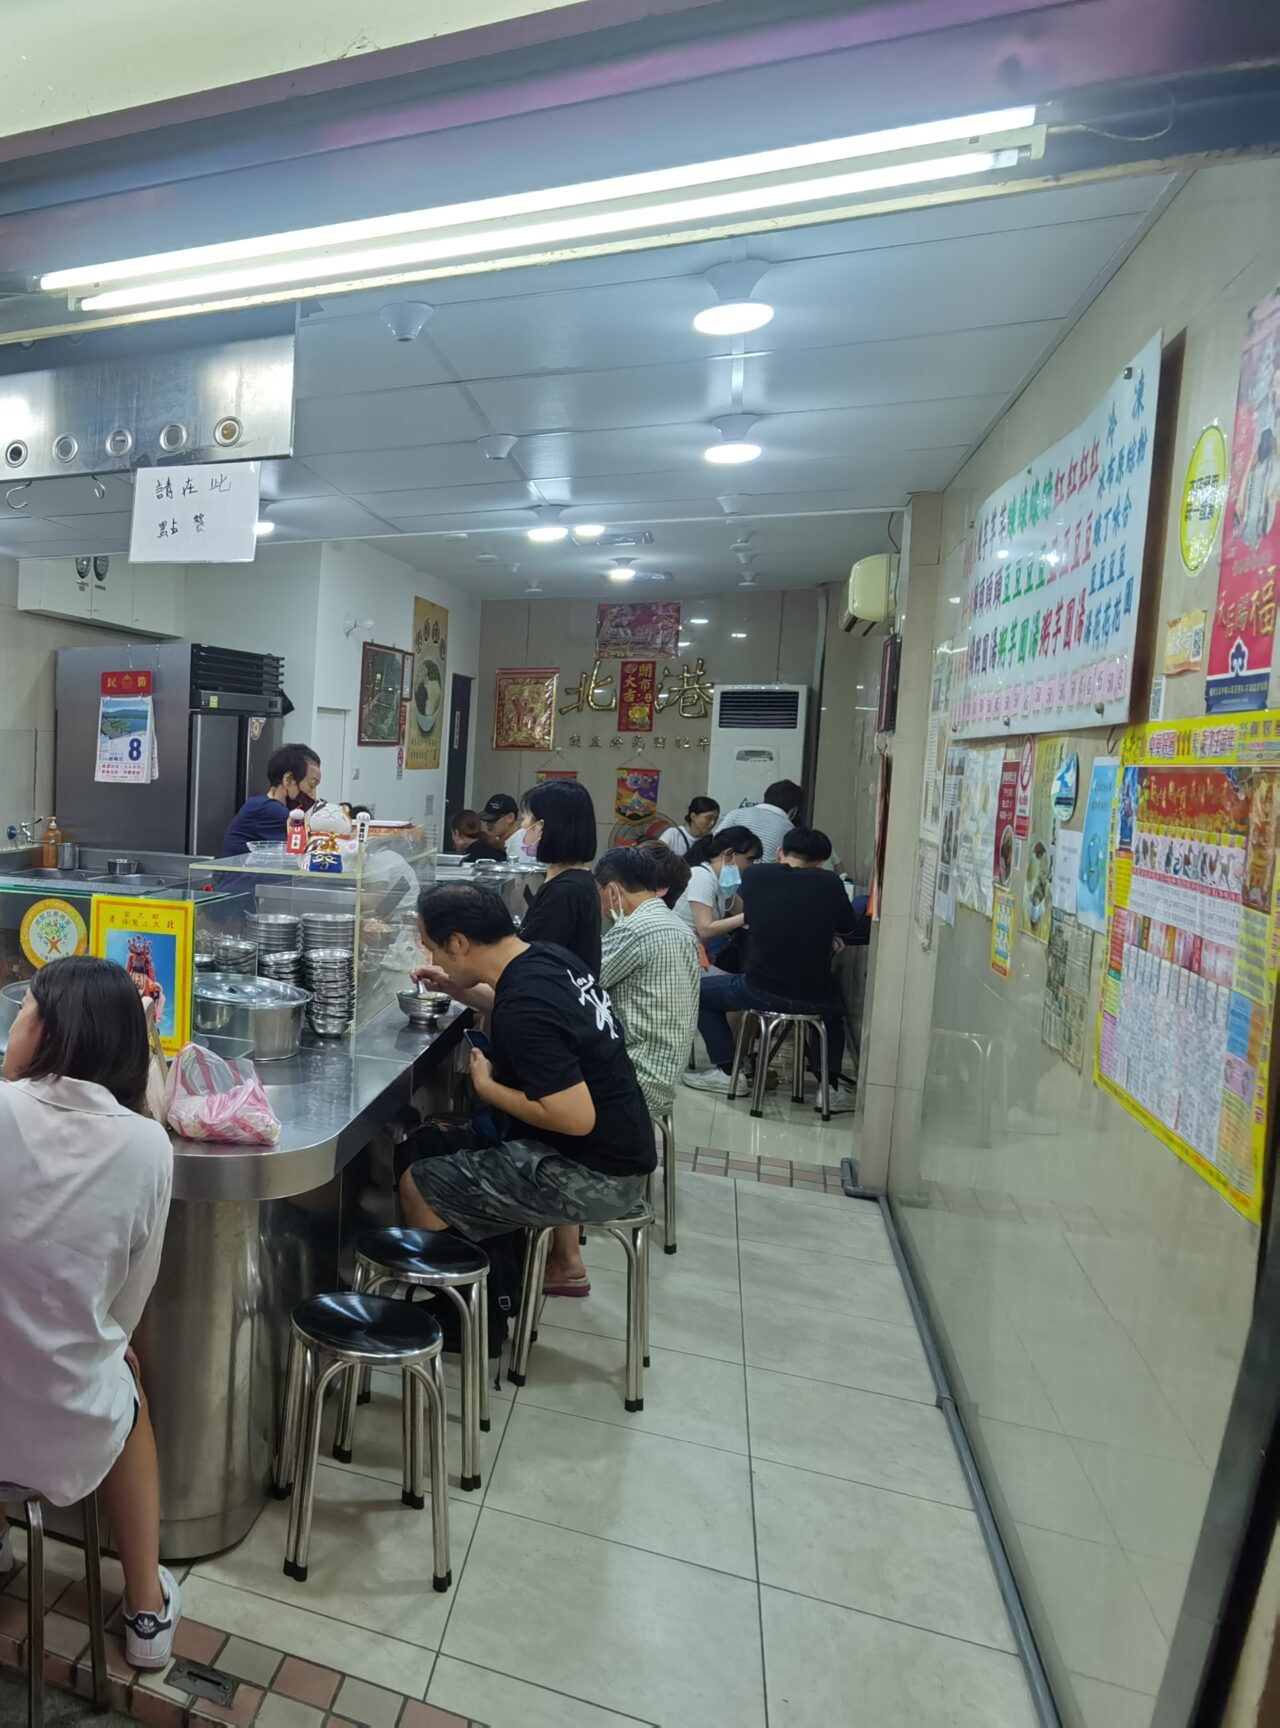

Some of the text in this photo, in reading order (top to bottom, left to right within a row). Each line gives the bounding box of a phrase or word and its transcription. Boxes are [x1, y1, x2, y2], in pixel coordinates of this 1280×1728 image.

[155, 473, 232, 500] 請在此
[128, 738, 142, 762] 8
